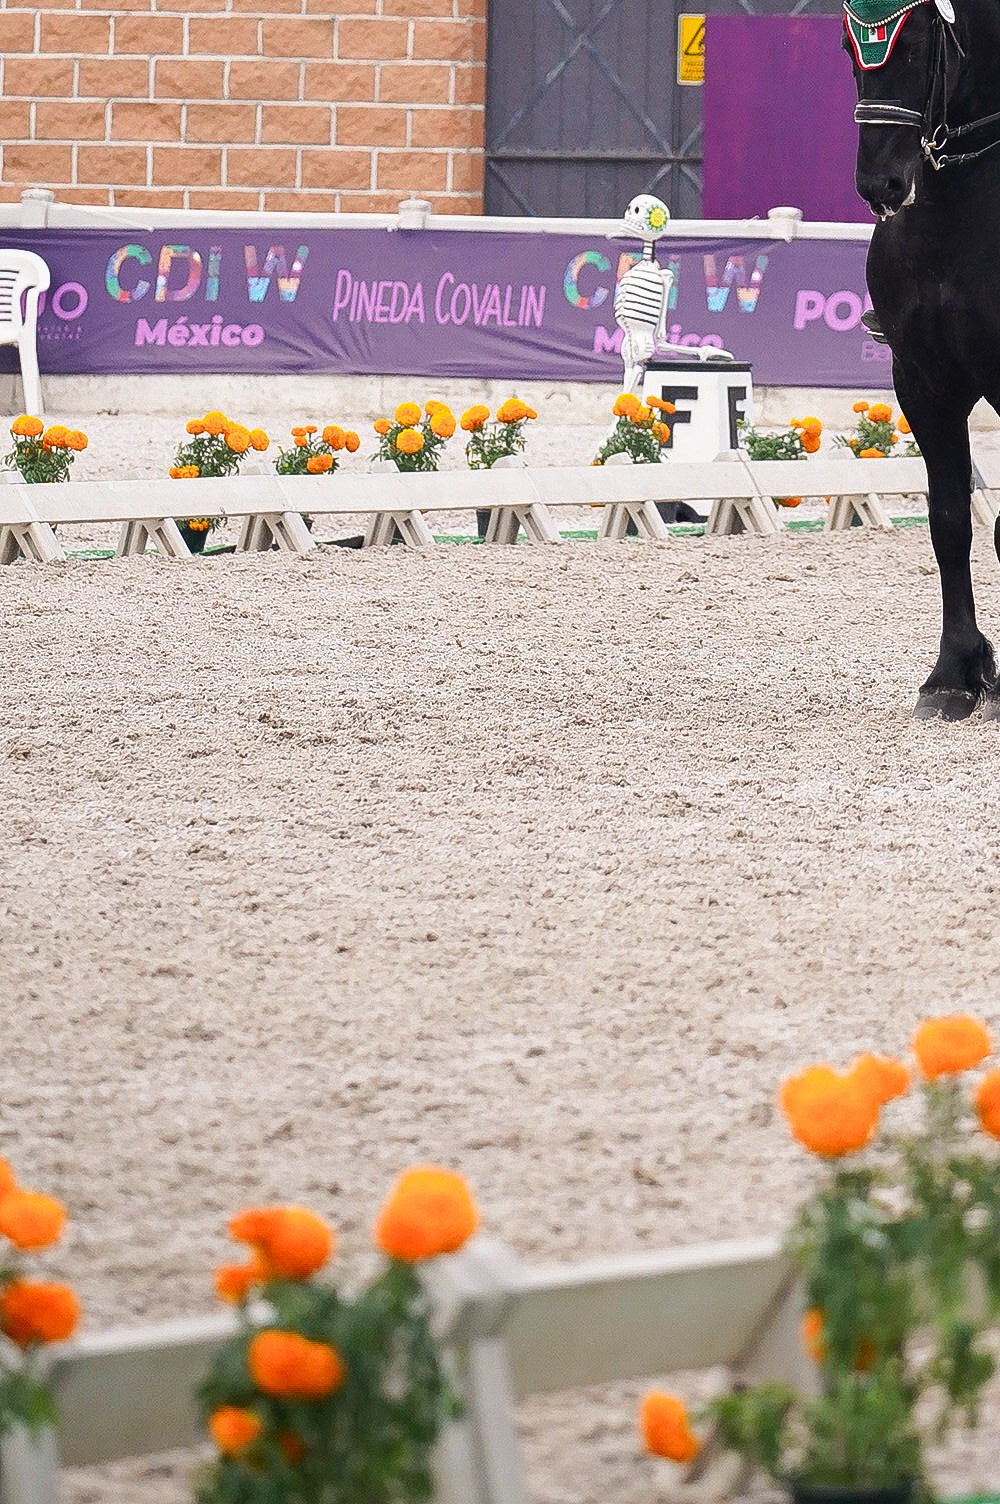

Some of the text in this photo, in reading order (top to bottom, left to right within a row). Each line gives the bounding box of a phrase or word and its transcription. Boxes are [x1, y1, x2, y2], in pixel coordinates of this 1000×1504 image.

[105, 244, 309, 302] CDI W
[332, 269, 546, 327] PINEDA COVALIN
[702, 254, 768, 313] W
[135, 314, 265, 347] México
[661, 385, 699, 448] F
